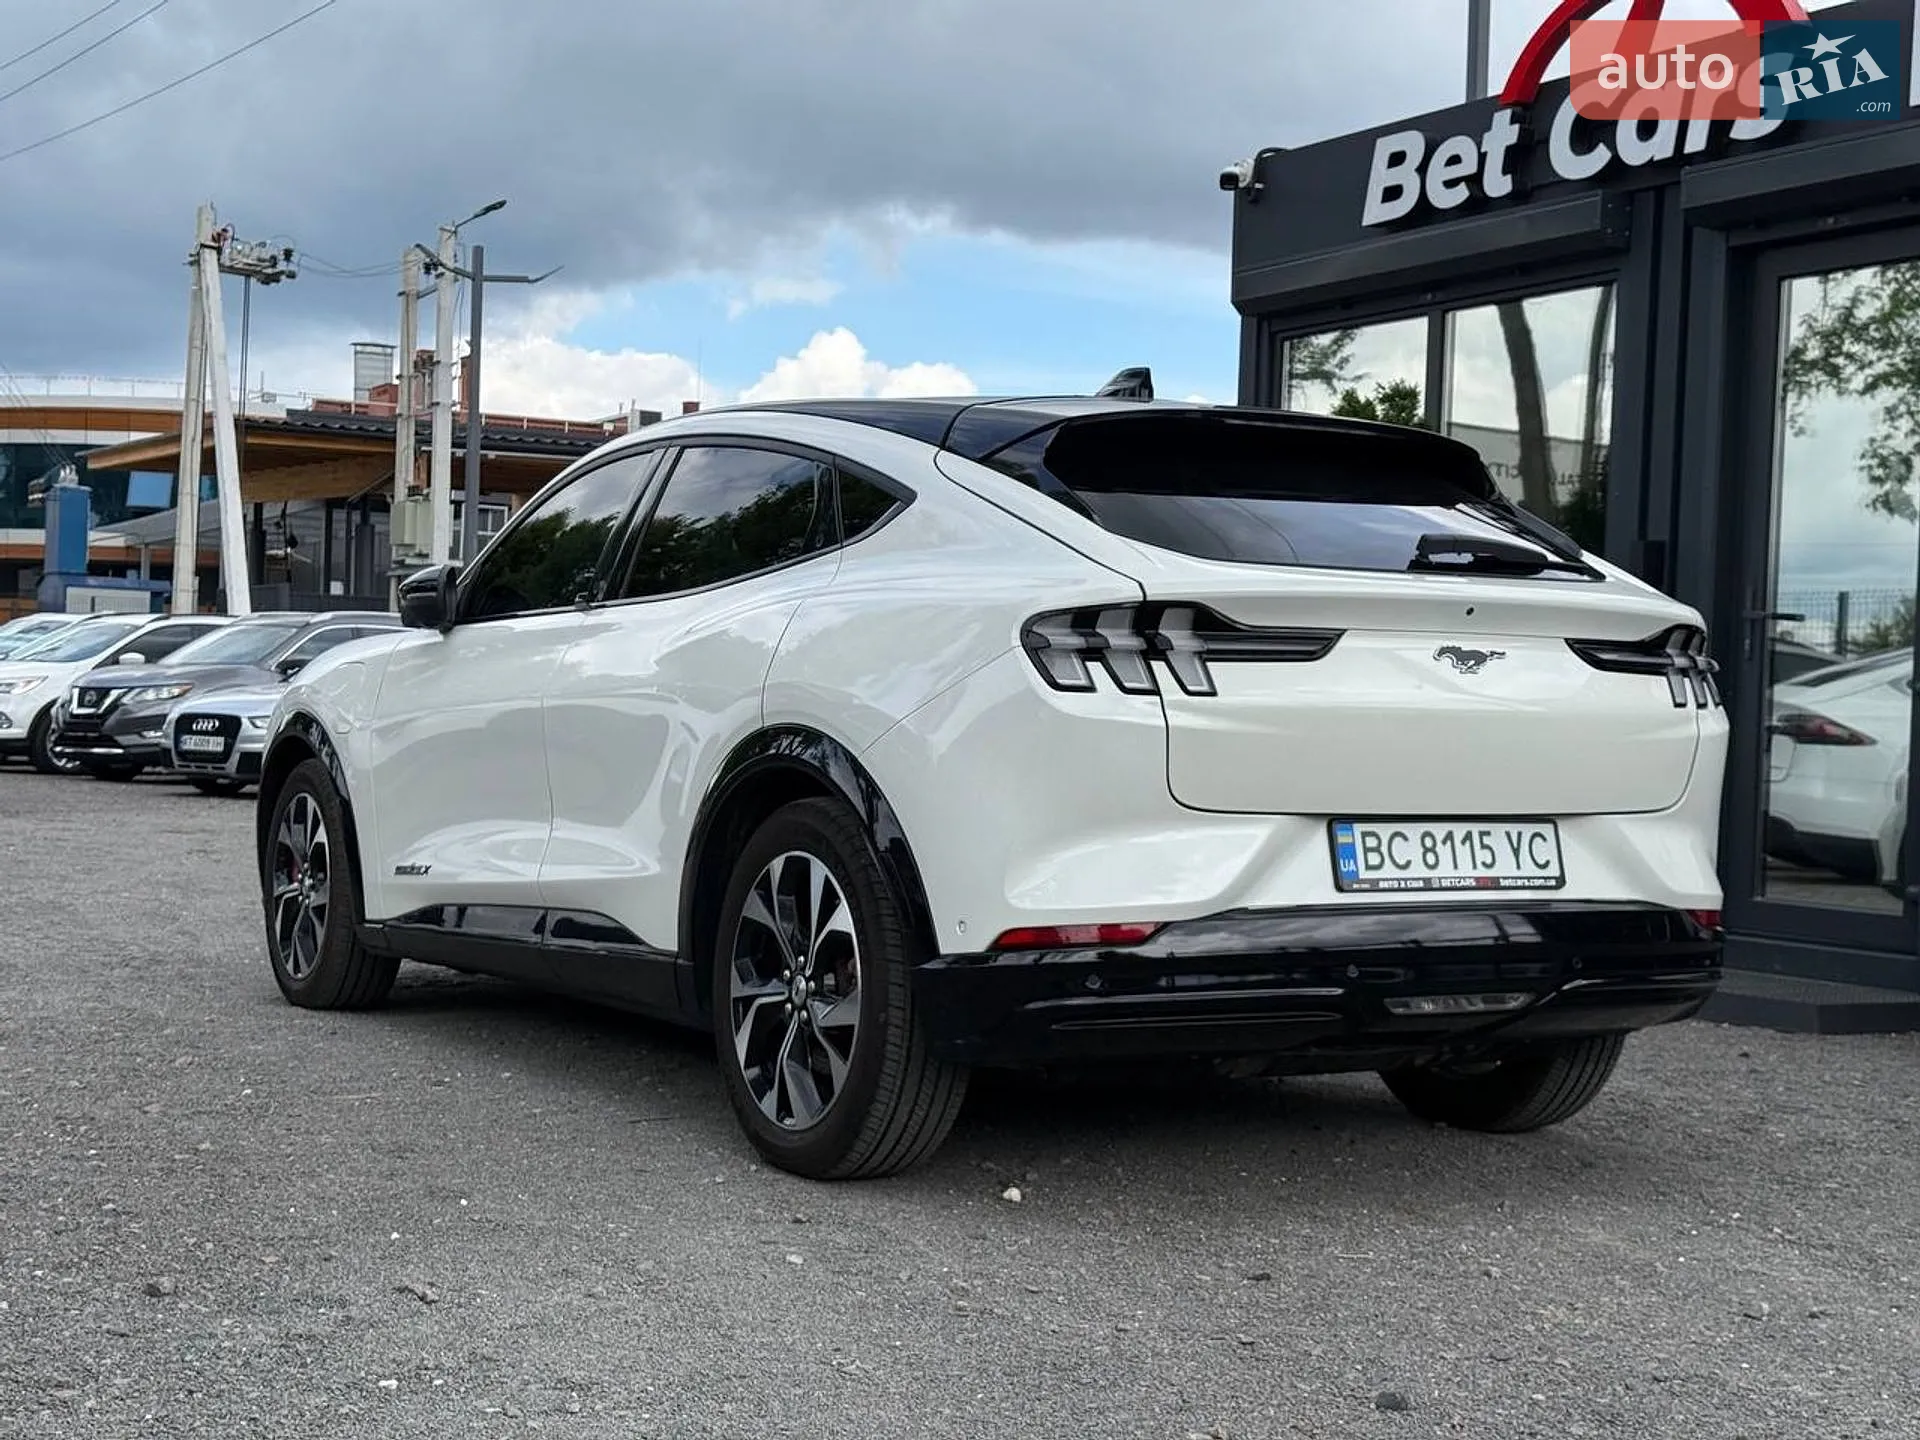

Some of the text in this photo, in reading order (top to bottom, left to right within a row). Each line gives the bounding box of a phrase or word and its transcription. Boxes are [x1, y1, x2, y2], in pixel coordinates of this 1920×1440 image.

[1361, 52, 1795, 227] Bet Cars
[1340, 858, 1357, 872] UA
[1361, 830, 1550, 871] BC 8115 YC
